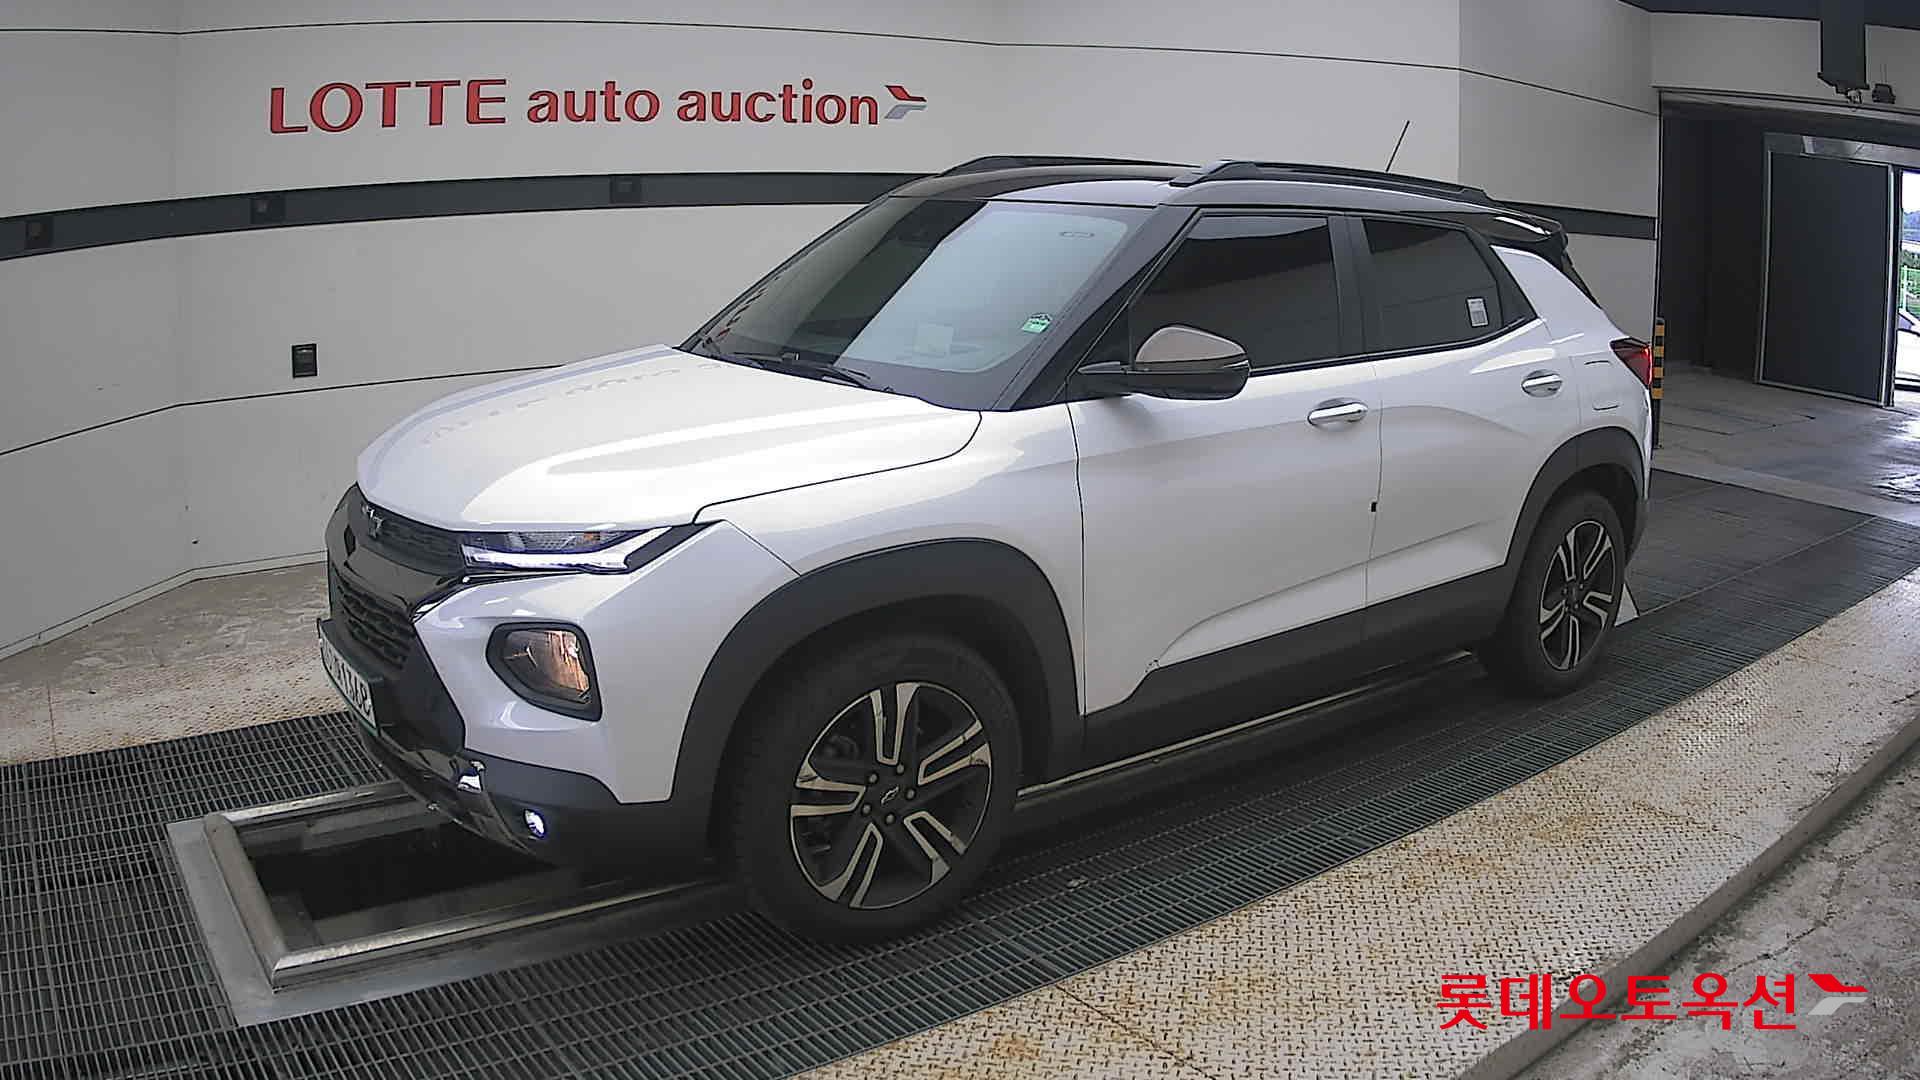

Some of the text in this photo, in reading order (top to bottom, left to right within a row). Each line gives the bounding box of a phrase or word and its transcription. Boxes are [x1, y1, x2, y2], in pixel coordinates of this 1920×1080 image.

[270, 77, 879, 134] LOTTE auto auction
